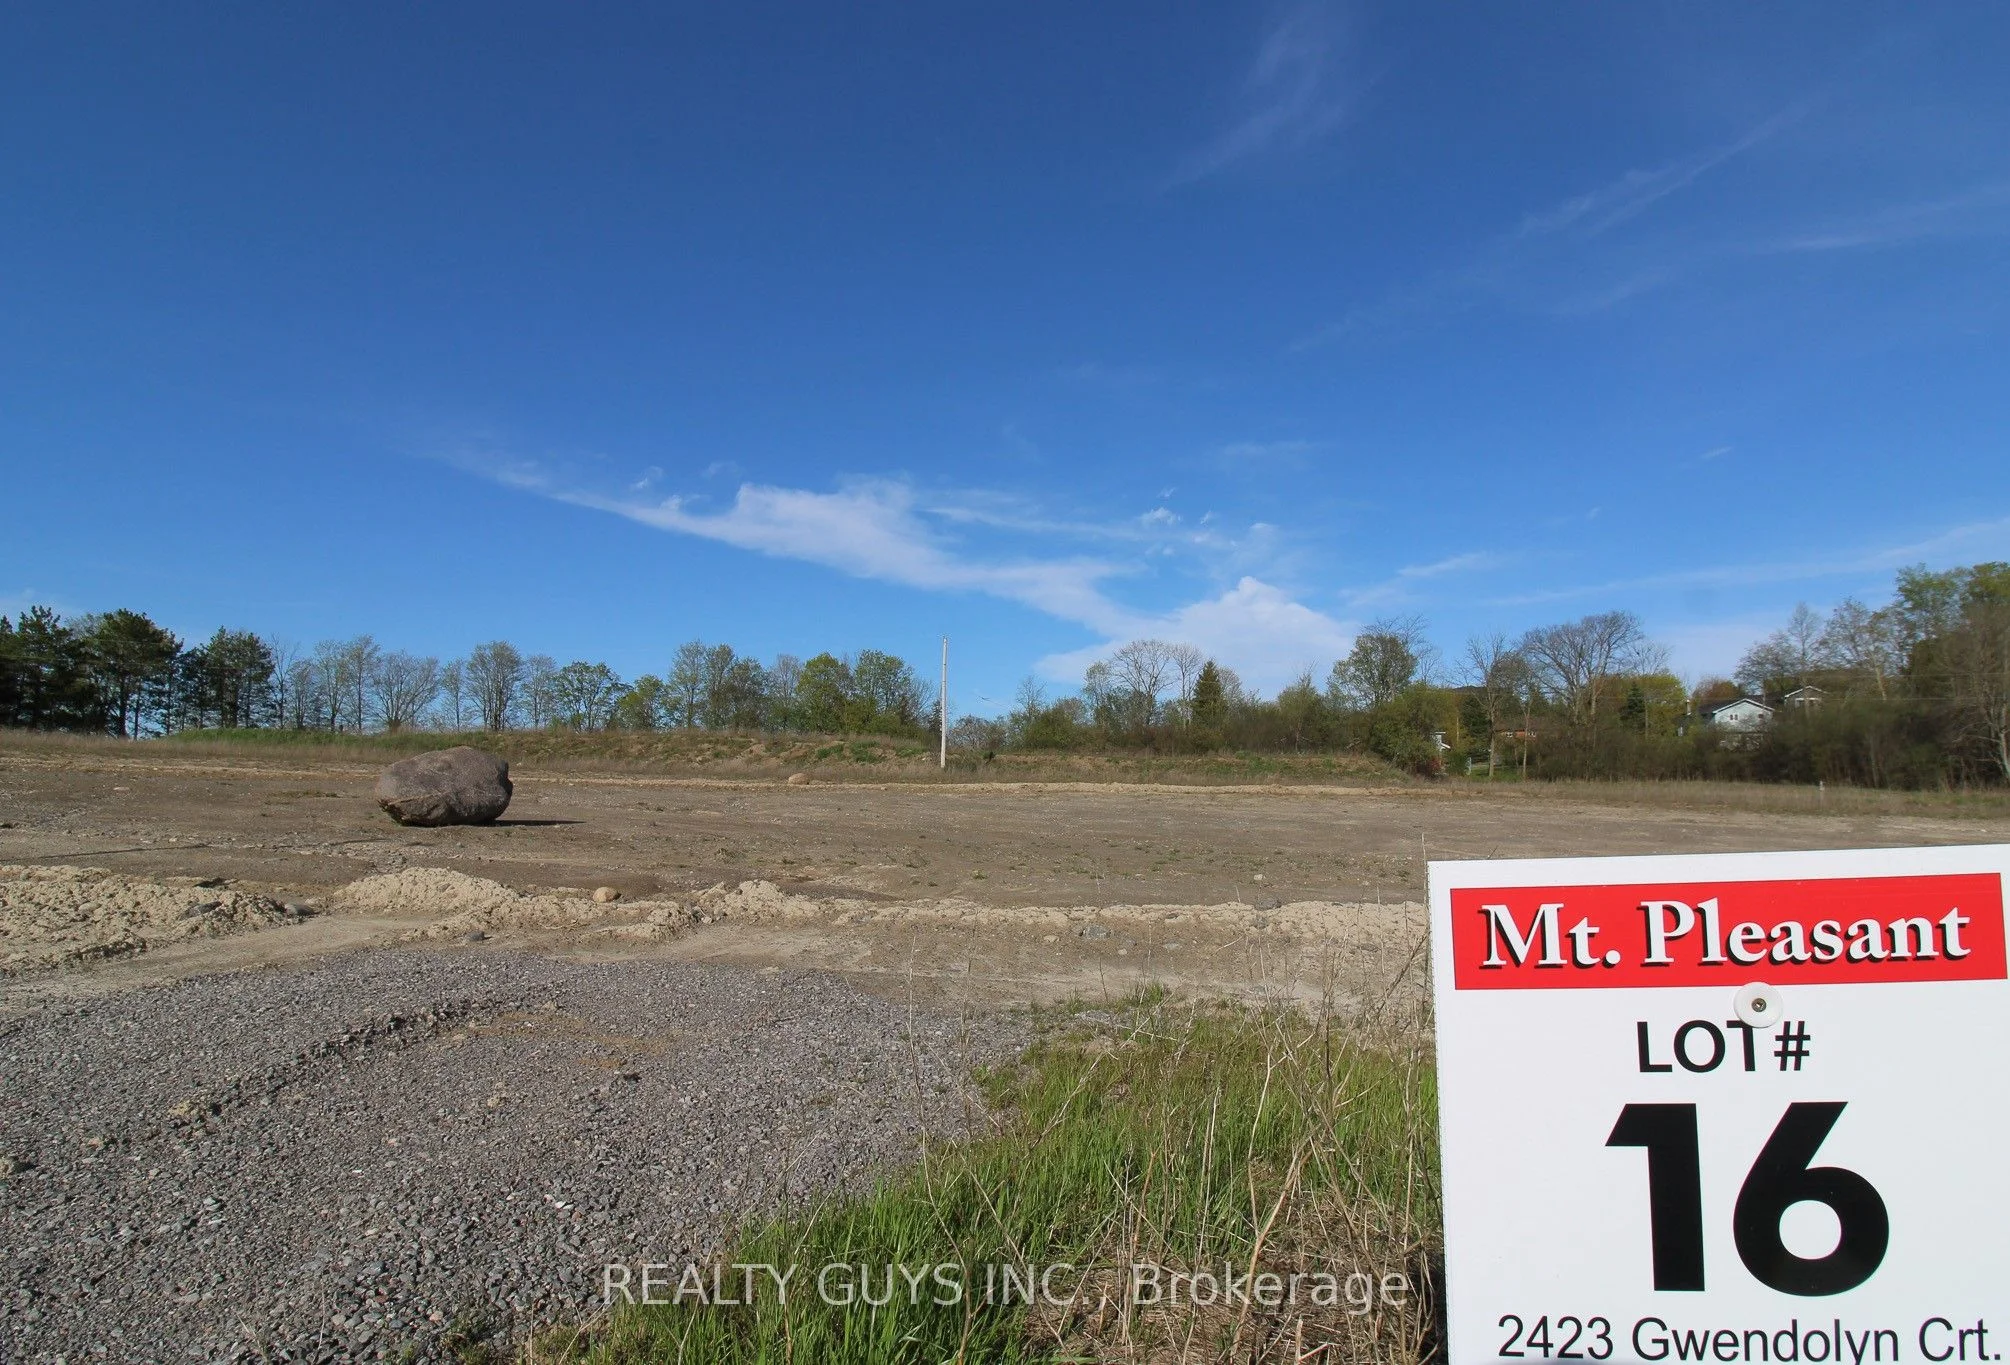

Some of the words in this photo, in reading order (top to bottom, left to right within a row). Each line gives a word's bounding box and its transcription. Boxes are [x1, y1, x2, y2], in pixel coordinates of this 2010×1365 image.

[1479, 902, 1622, 970] Mt.
[1637, 896, 1972, 969] Pleasant
[1605, 1101, 1890, 1297] 16
[1498, 1315, 1614, 1359] 2423
[1631, 1317, 1899, 1365] Gwendolyn
[1918, 1316, 2001, 1361] Crt.
